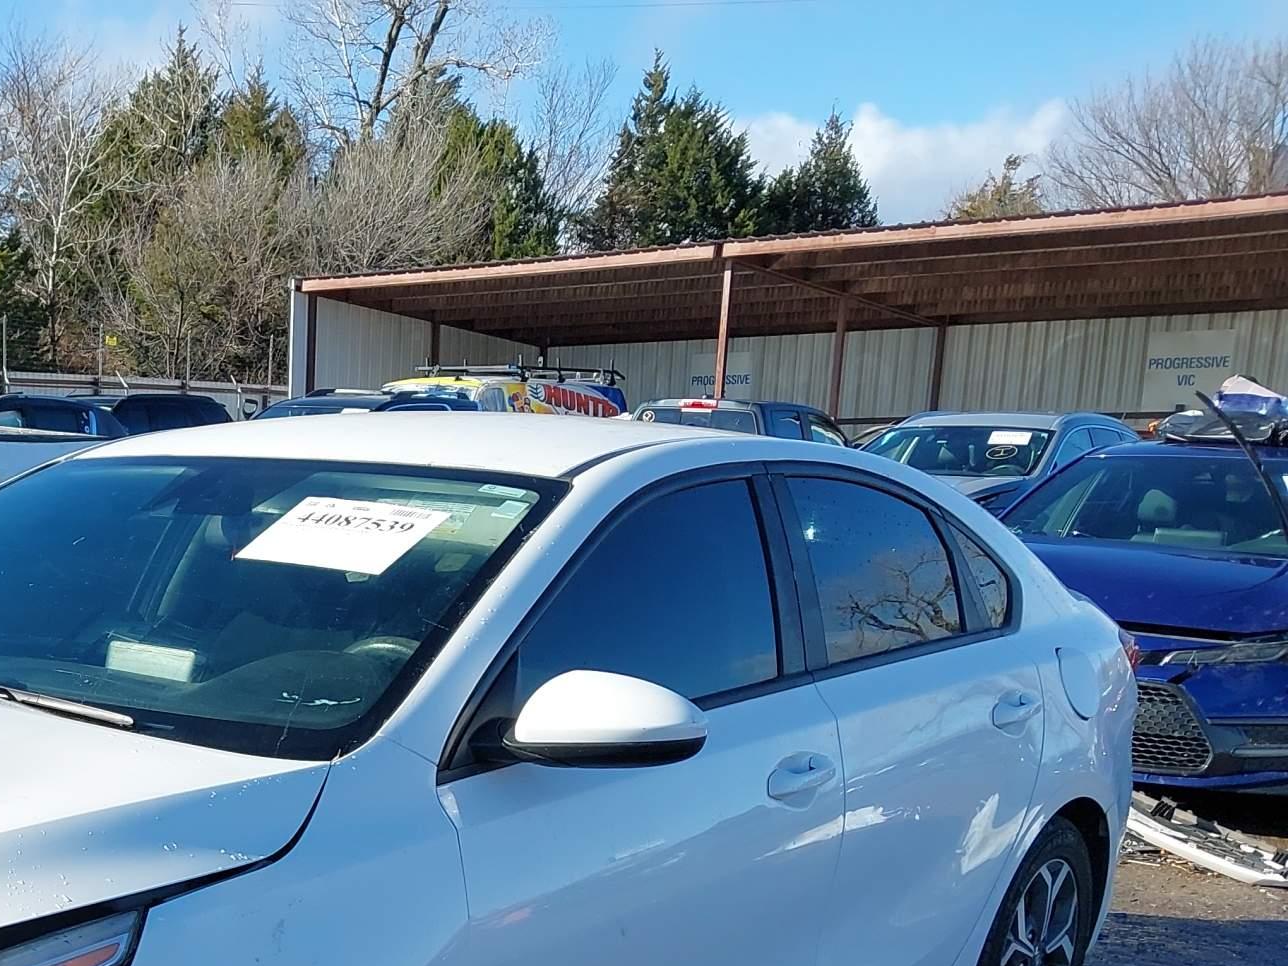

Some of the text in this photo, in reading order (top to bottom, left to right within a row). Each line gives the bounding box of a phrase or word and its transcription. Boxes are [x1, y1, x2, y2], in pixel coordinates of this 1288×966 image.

[1148, 356, 1231, 369] PROGRESSIVE
[691, 373, 751, 387] PROGSSIVE
[1176, 374, 1196, 387] VIC
[296, 511, 414, 535] 44087539
